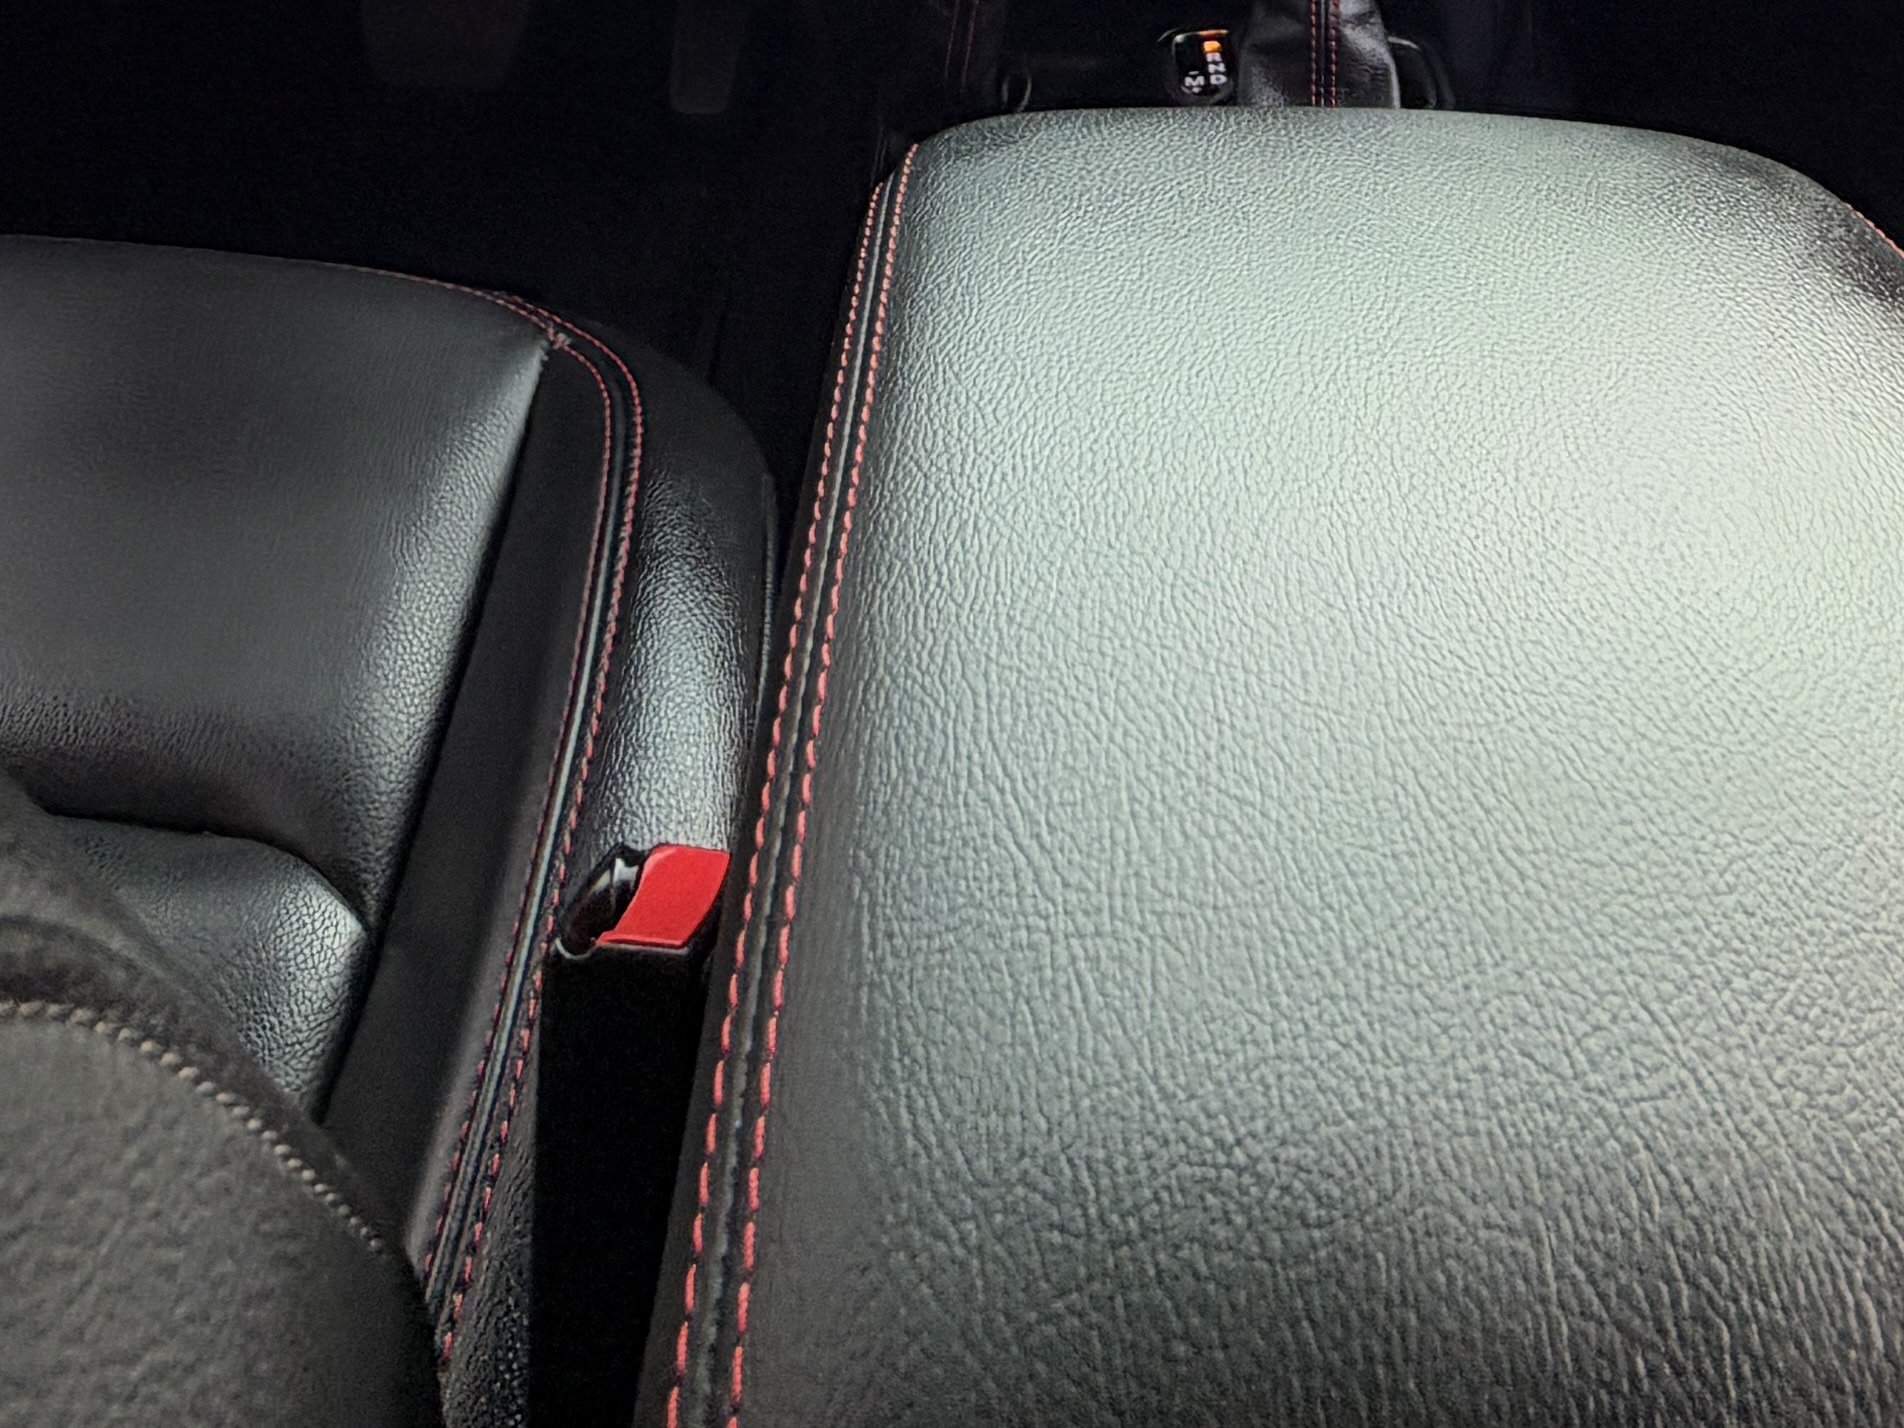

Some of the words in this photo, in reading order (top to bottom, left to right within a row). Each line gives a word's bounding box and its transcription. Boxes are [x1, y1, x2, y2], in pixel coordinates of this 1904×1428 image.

[1208, 63, 1226, 73] N
[1184, 75, 1205, 86] M
[1210, 74, 1227, 85] D
